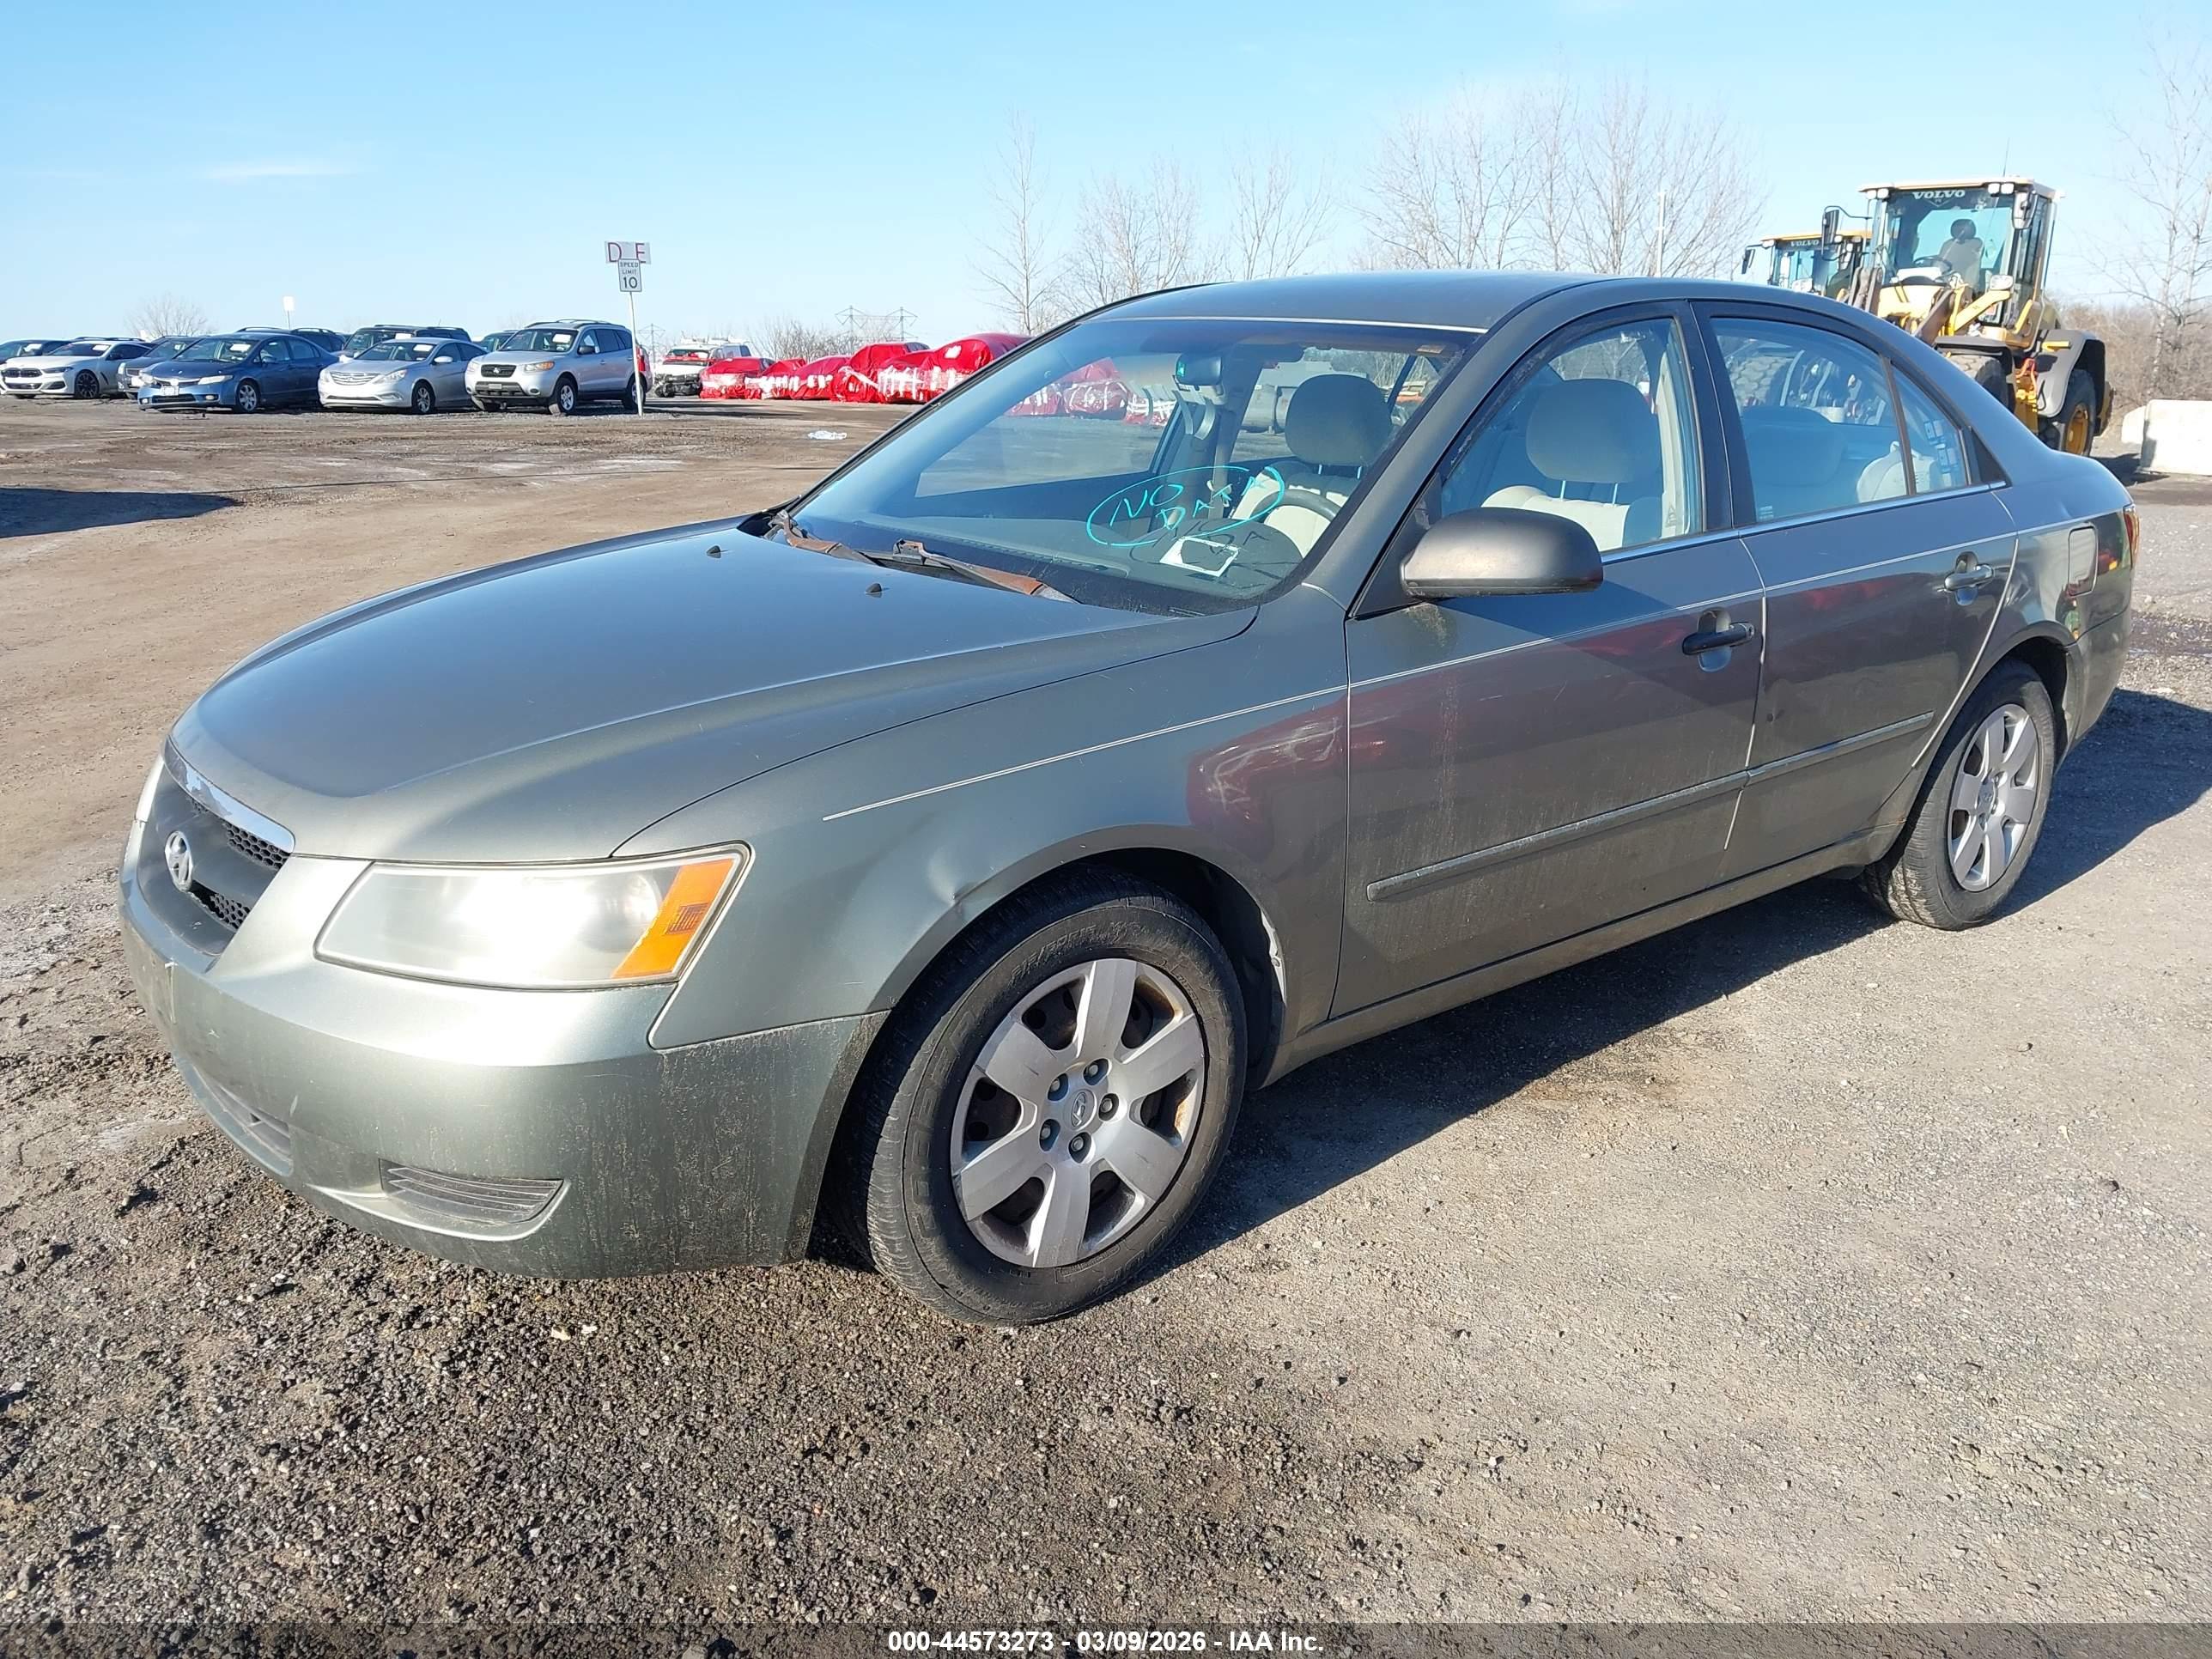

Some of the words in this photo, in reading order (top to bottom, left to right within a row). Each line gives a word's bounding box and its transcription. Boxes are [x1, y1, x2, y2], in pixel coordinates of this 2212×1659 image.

[1911, 189, 1966, 199] VOLVO
[607, 242, 623, 263] D
[623, 276, 638, 289] 10
[1109, 483, 1184, 527] NO
